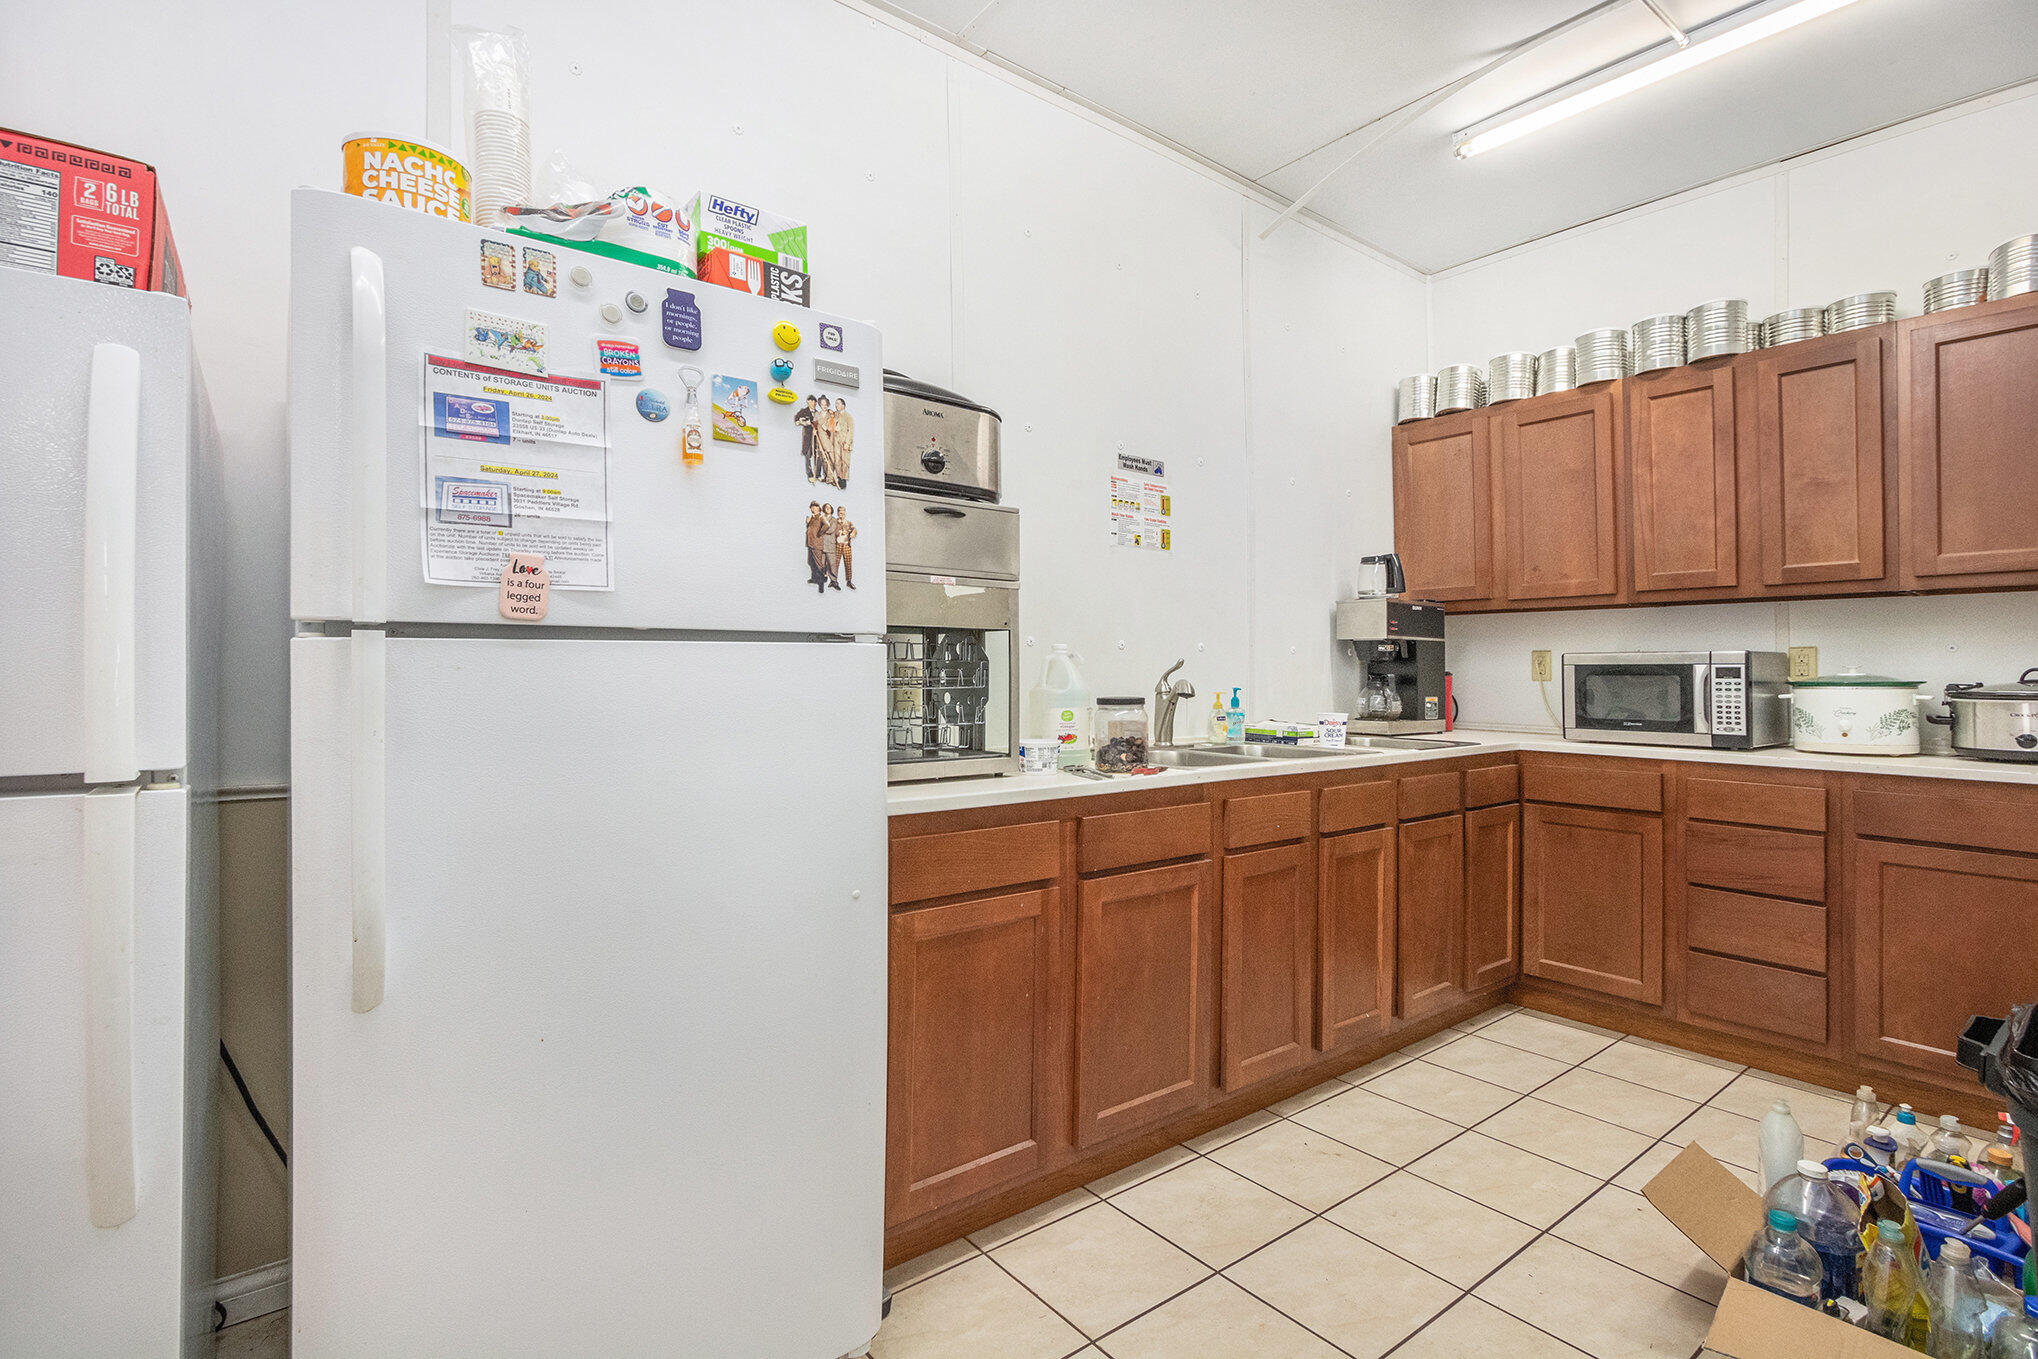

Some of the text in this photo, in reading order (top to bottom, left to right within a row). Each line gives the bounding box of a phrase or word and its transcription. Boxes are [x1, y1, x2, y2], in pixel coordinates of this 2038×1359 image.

[0, 161, 33, 172] utrition
[364, 151, 458, 190] NACHO
[84, 183, 96, 198] 2
[106, 182, 139, 207] 6 LB
[362, 170, 460, 210] CHEESE
[105, 202, 139, 220] TOTAL
[712, 199, 755, 223] Hefty
[716, 215, 752, 230] CLEAR PLASTIC
[714, 228, 753, 242] HEAVY WEIGHT
[724, 224, 744, 234] SPOONS
[707, 235, 727, 249] 300
[770, 267, 780, 299] PLASTIC
[780, 272, 803, 304] KS
[670, 303, 686, 311] don't
[674, 327, 699, 338] morning
[672, 335, 693, 343] people
[604, 348, 636, 358] BROKEN
[601, 356, 639, 366] CRAYONS
[817, 365, 858, 380] FRIGIDAIRE
[433, 367, 480, 380] CONTENTS
[493, 377, 536, 388] STORAGE
[536, 382, 560, 392] UNITS
[562, 387, 598, 397] AUCTION
[483, 386, 507, 395] Friday,
[509, 390, 524, 398] April
[922, 408, 944, 419] AROMA
[1119, 454, 1141, 464] Employees
[480, 465, 513, 474] Saturday,
[452, 487, 498, 497] Spacemaker
[507, 578, 514, 587] is
[525, 580, 545, 589] four
[507, 591, 541, 603] legged
[511, 606, 538, 615] word.
